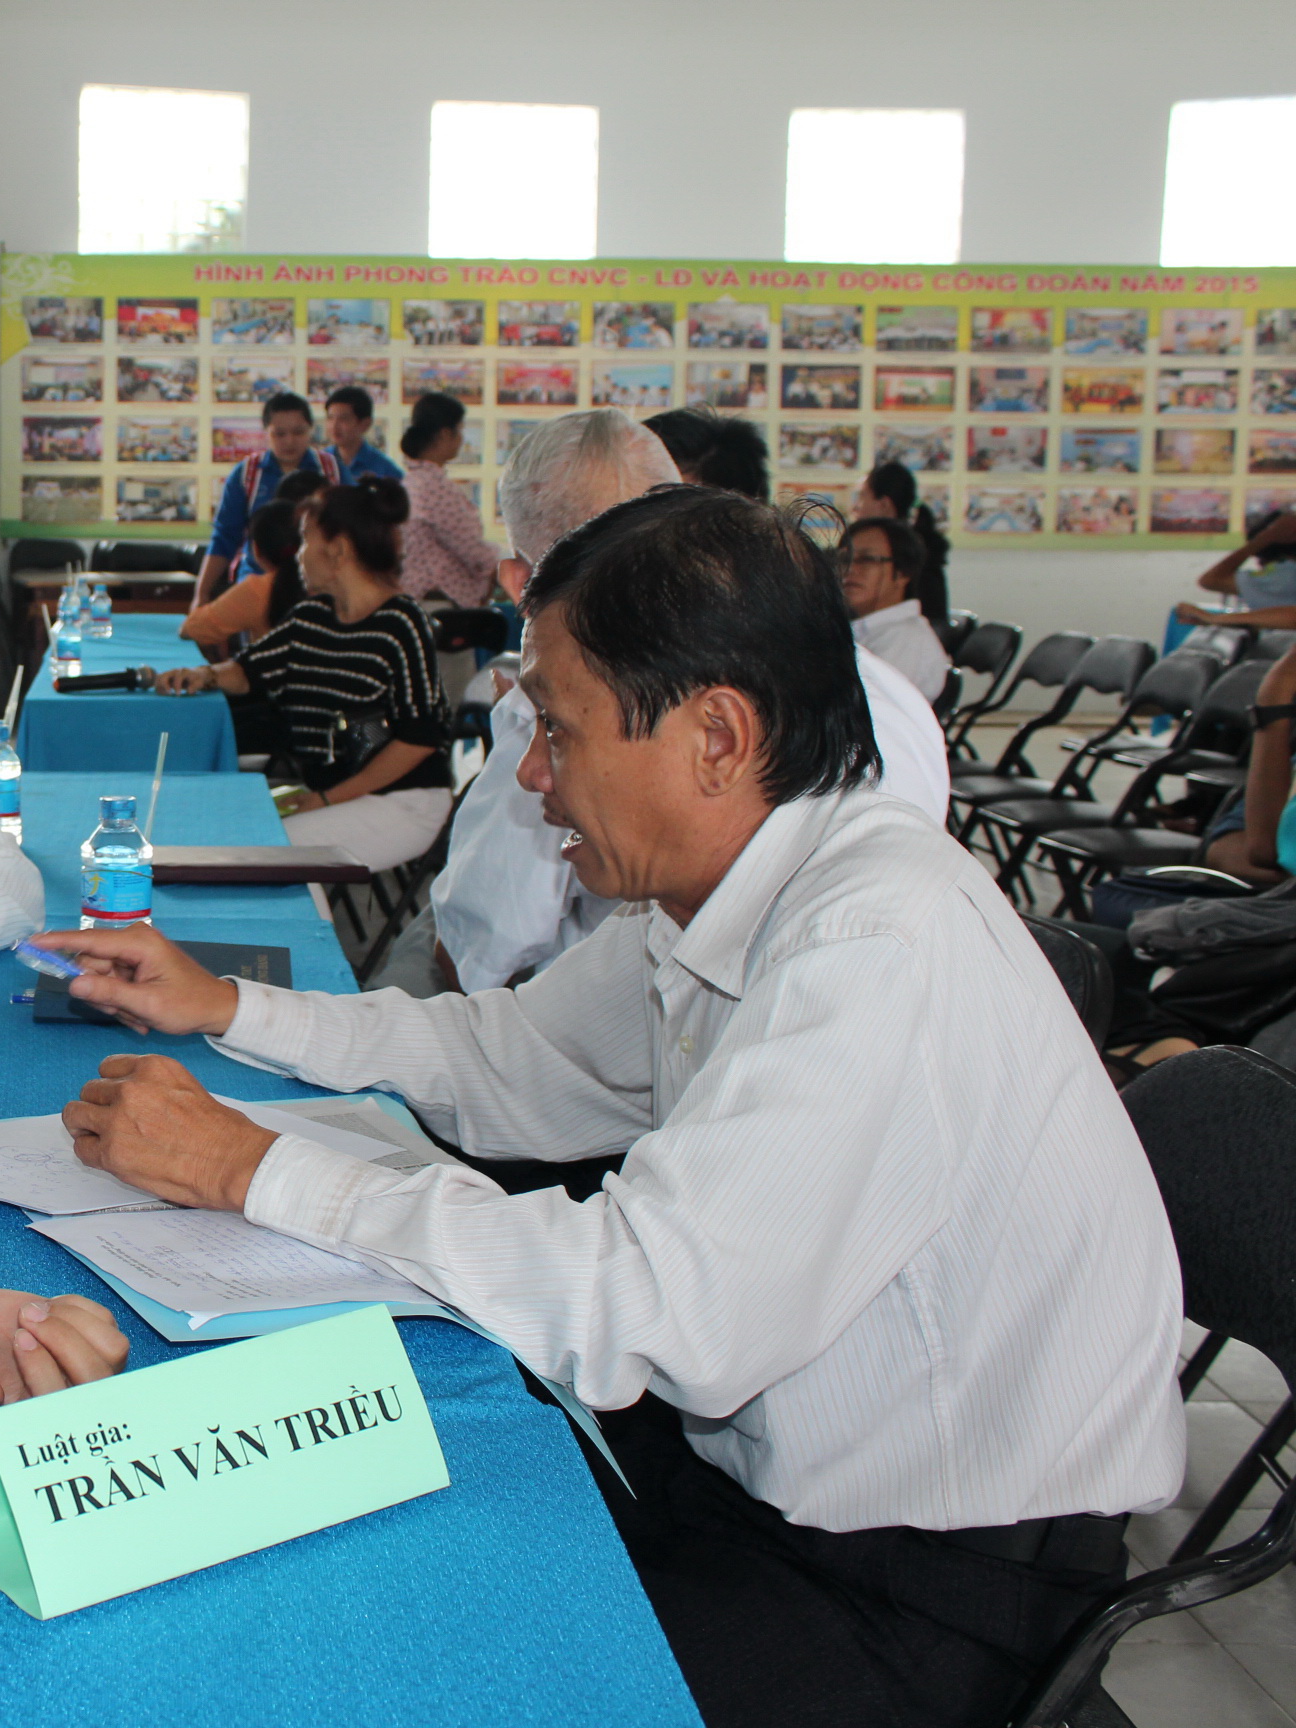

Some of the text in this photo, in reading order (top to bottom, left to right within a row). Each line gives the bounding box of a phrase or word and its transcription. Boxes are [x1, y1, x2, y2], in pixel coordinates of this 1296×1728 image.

[194, 260, 263, 282] HÌNH
[344, 265, 449, 284] PHONG
[458, 263, 540, 285] TRÀO
[548, 266, 628, 286] CNVC
[701, 265, 740, 289] VÀ
[931, 269, 1018, 293] CÔNG
[1119, 270, 1186, 293] NĂM
[1193, 275, 1260, 294] 2015
[16, 1423, 132, 1468] Luật gia:
[34, 1384, 404, 1523] TRẦN VĂN TRIỀU
